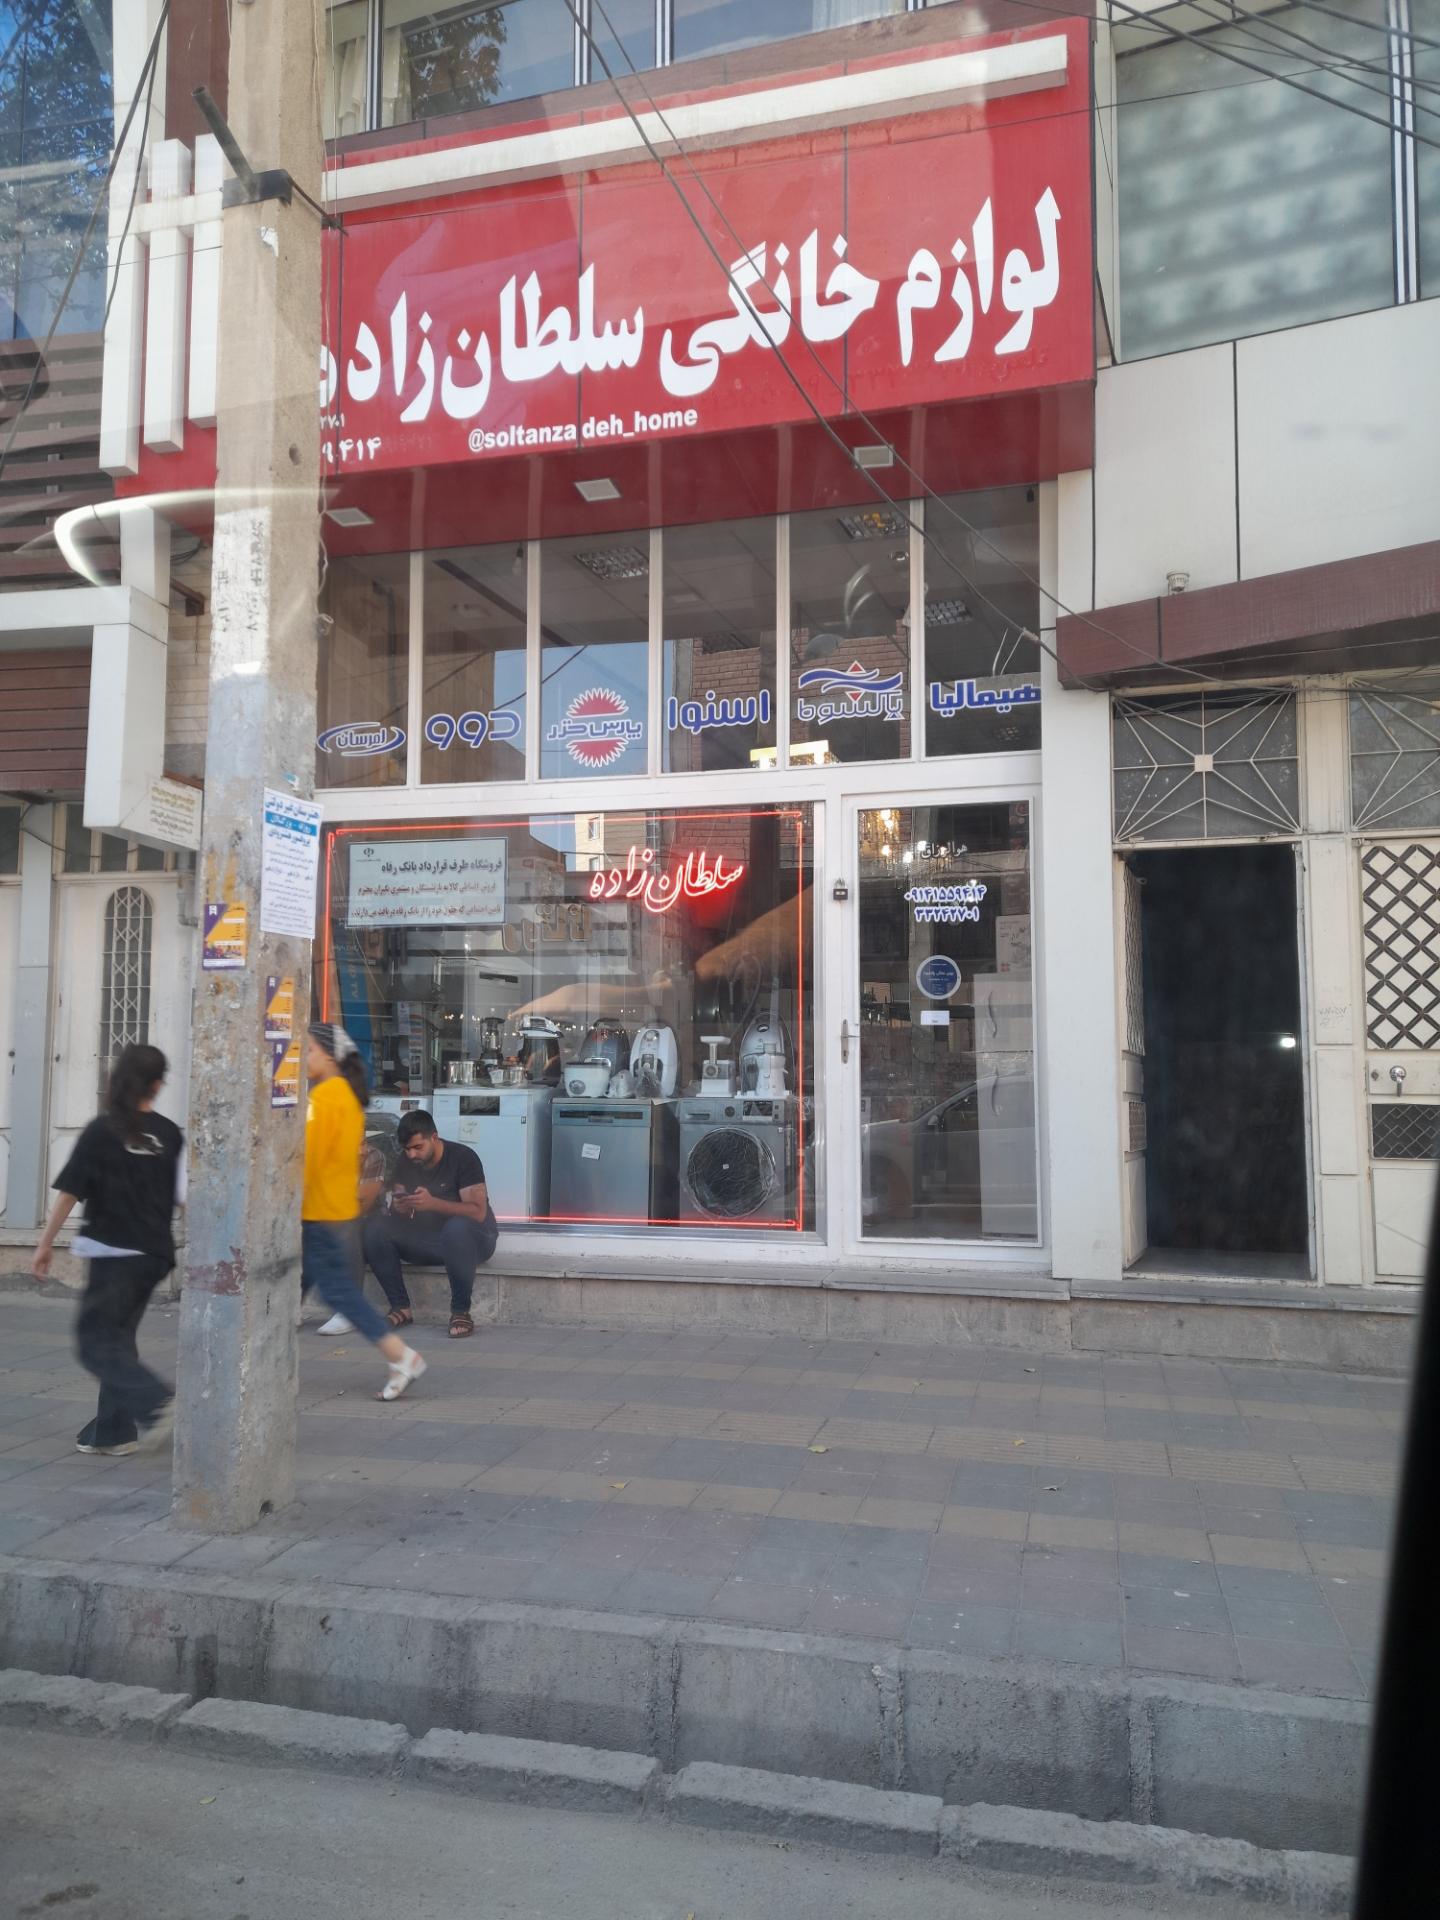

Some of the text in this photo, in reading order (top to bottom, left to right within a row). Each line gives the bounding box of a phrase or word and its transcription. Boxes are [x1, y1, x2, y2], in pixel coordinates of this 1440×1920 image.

[897, 186, 1062, 367] لوازم
[660, 227, 881, 397] خانگی
[667, 689, 770, 734] اسنوا
[930, 680, 1041, 717] هیمالیا
[425, 711, 522, 750] دوو
[590, 720, 642, 740] پارس
[381, 858, 502, 875] فروشگاه طرف قرارداد بانک رفاه
[589, 845, 744, 913] سلطان زاده
[904, 885, 987, 903] ۰۹۱۴۱۵۵۹۴۱۴
